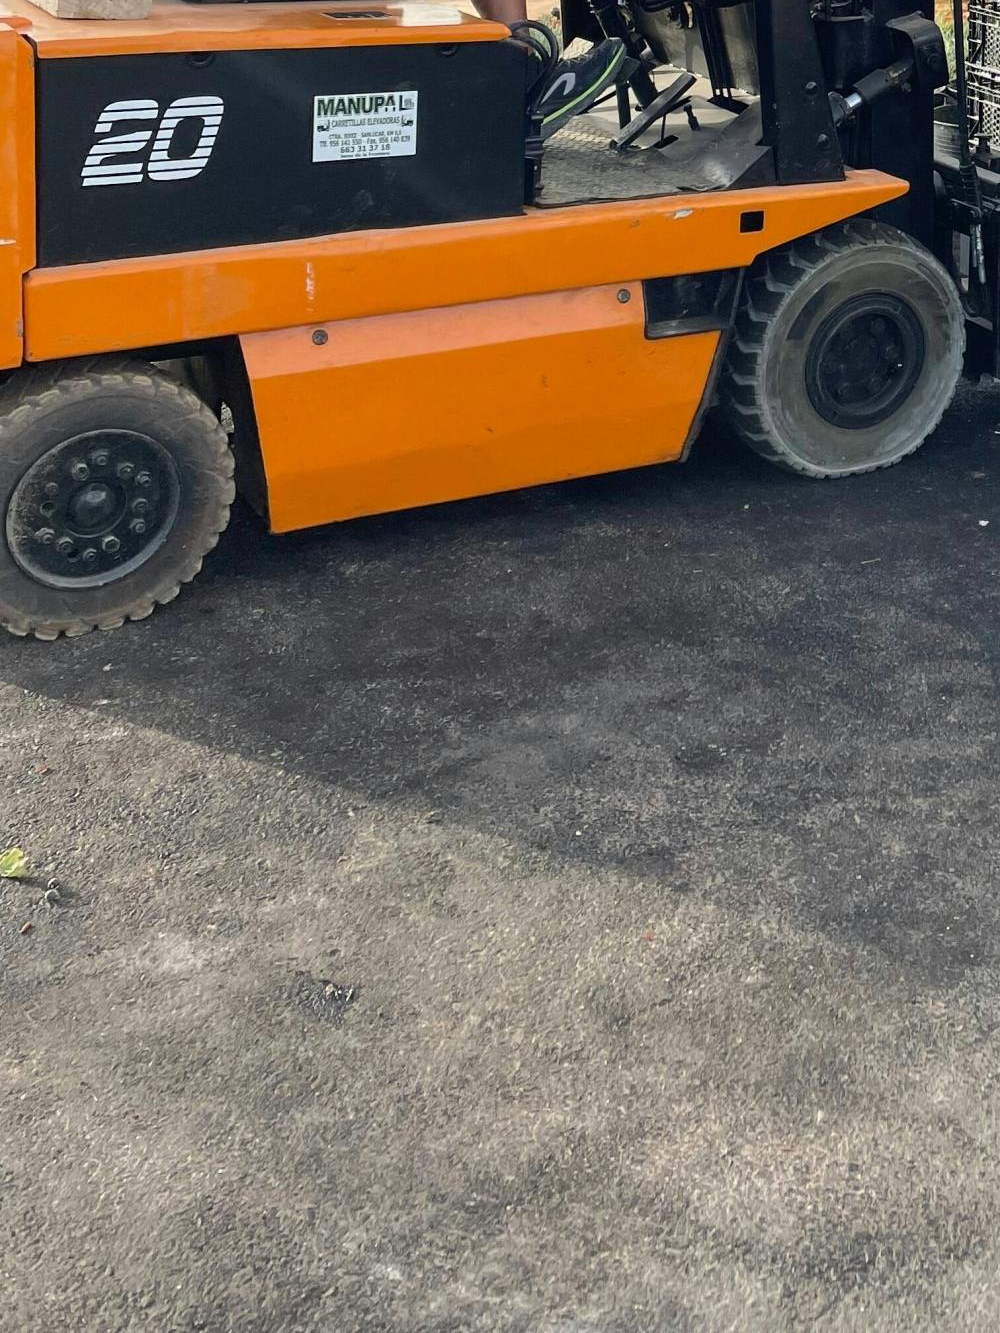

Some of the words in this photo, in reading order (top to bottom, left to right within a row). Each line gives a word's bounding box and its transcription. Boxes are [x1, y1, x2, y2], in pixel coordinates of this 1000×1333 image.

[317, 95, 413, 116] MANUPAL
[367, 116, 400, 126] ELEVADORAS
[80, 95, 225, 187] 20
[340, 146, 355, 154] 663
